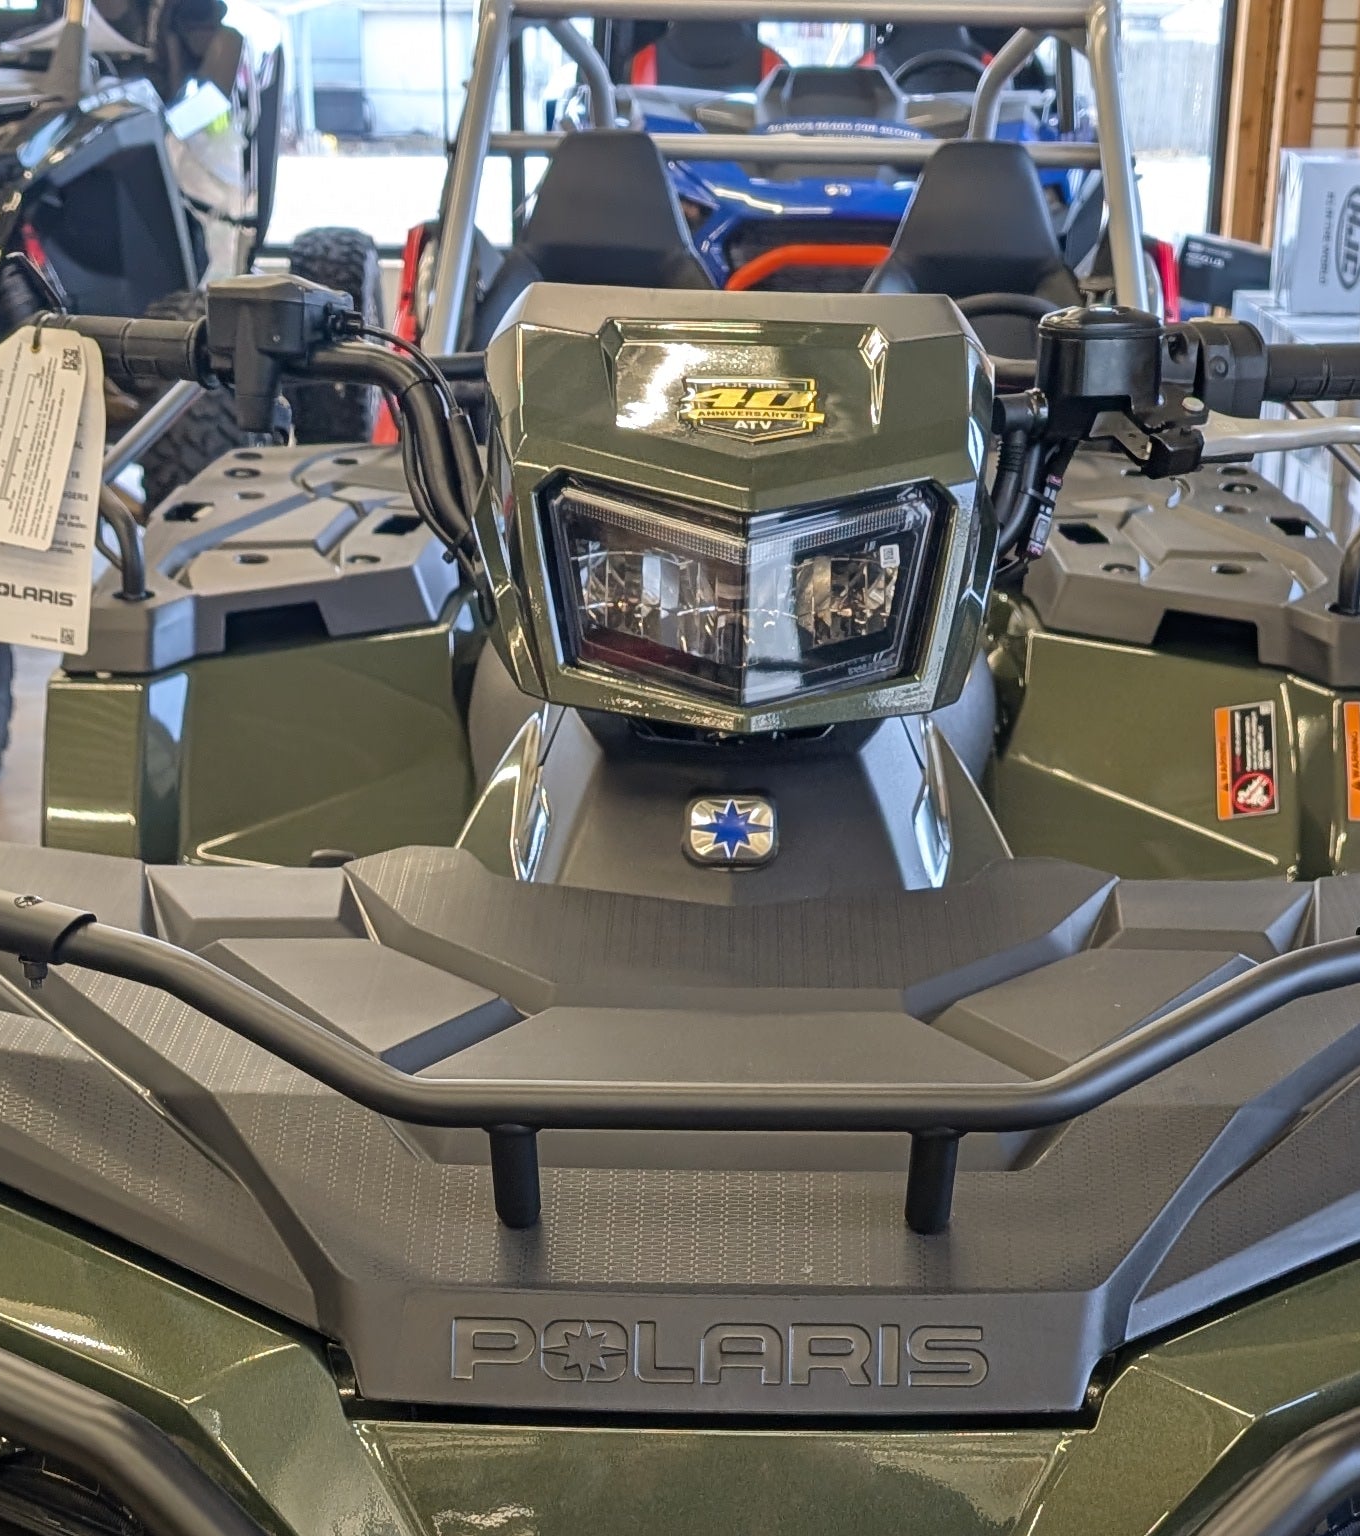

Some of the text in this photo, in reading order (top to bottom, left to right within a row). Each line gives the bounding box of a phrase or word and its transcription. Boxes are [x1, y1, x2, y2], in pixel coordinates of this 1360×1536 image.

[697, 410, 788, 420] ANNIVERSARY
[733, 419, 772, 430] ATV
[1351, 731, 1360, 779] WARNING
[451, 1316, 990, 1388] POLARIS
